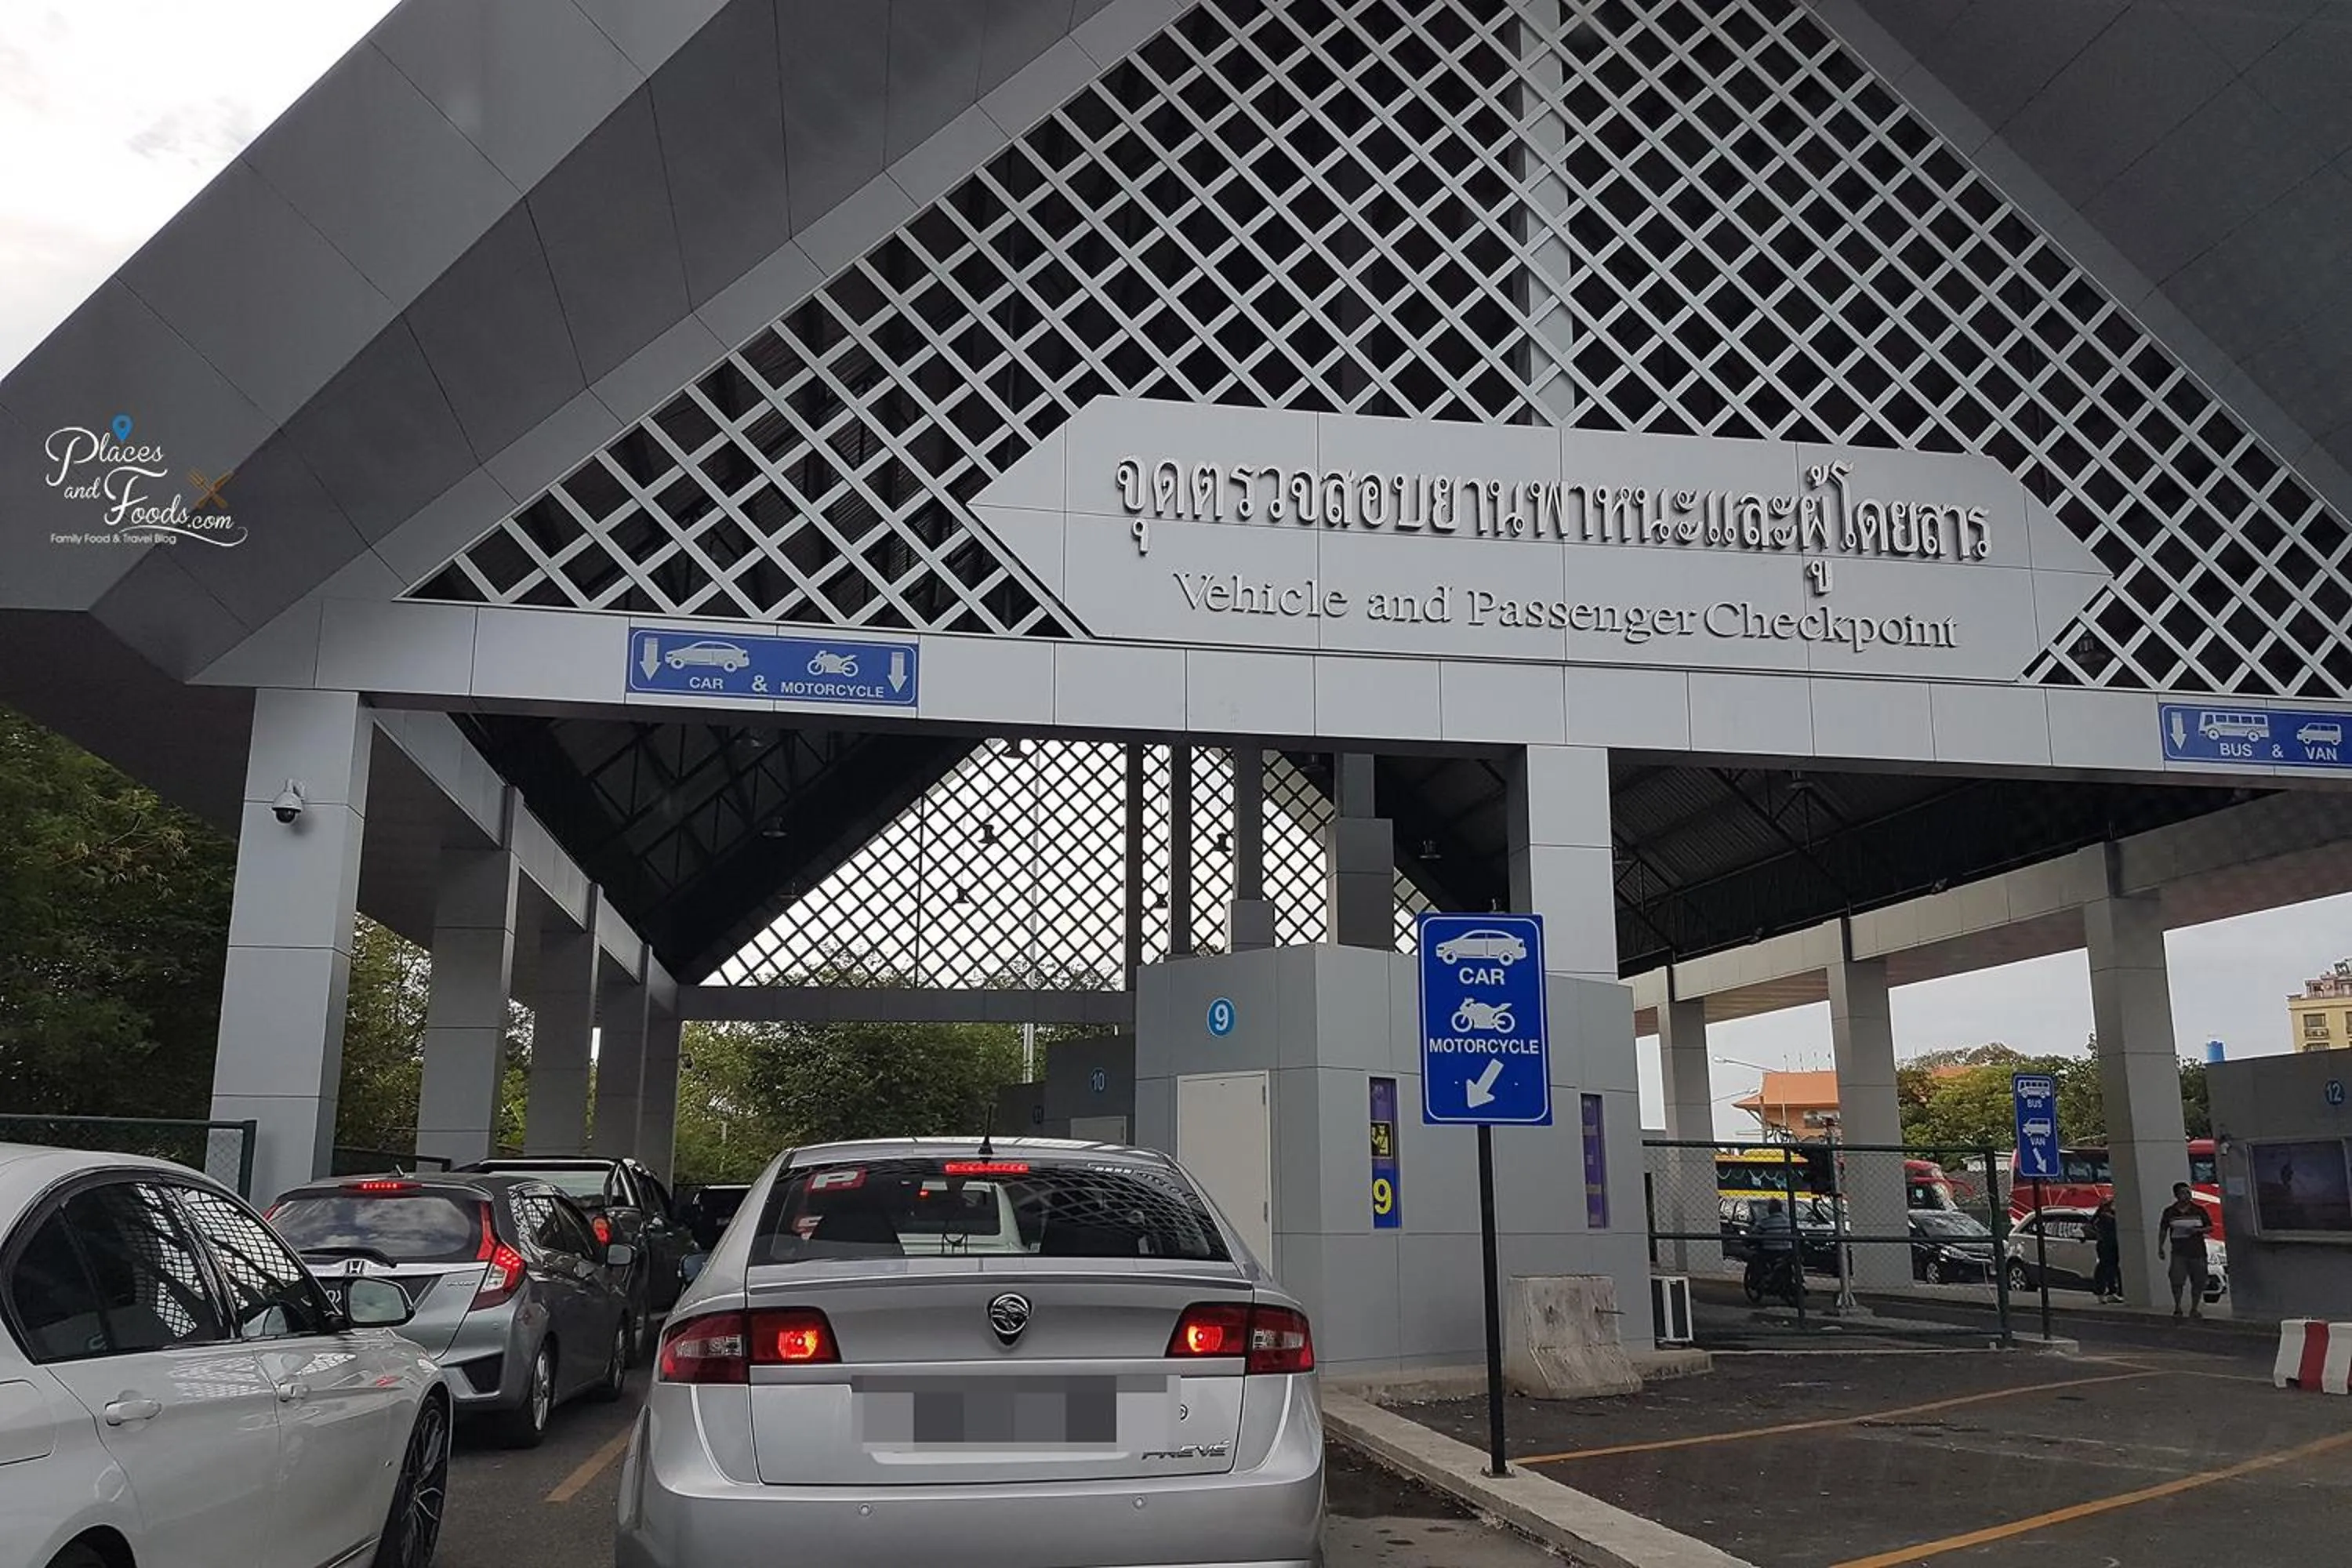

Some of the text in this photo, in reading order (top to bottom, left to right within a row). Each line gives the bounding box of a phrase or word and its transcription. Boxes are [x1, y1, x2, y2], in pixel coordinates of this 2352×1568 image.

[1115, 455, 1992, 595] จุดตรวจสอบยานพาหนะและผู้โดยสาร
[1173, 572, 1959, 653] Vehicle and Passenger Checkpoint
[689, 674, 884, 699] CAR & MOTORCYCLE
[2220, 742, 2339, 760] BUS & VAN
[1458, 967, 1506, 985] CAR
[1214, 1004, 1229, 1031] 9
[1429, 1037, 1541, 1054] MOTORCYCLE
[1091, 1071, 1105, 1091] 10
[2326, 1083, 2343, 1102] 12
[2027, 1098, 2043, 1109] BUS
[2030, 1137, 2046, 1146] VAN
[811, 1171, 858, 1189] P
[1373, 1178, 1392, 1214] 9
